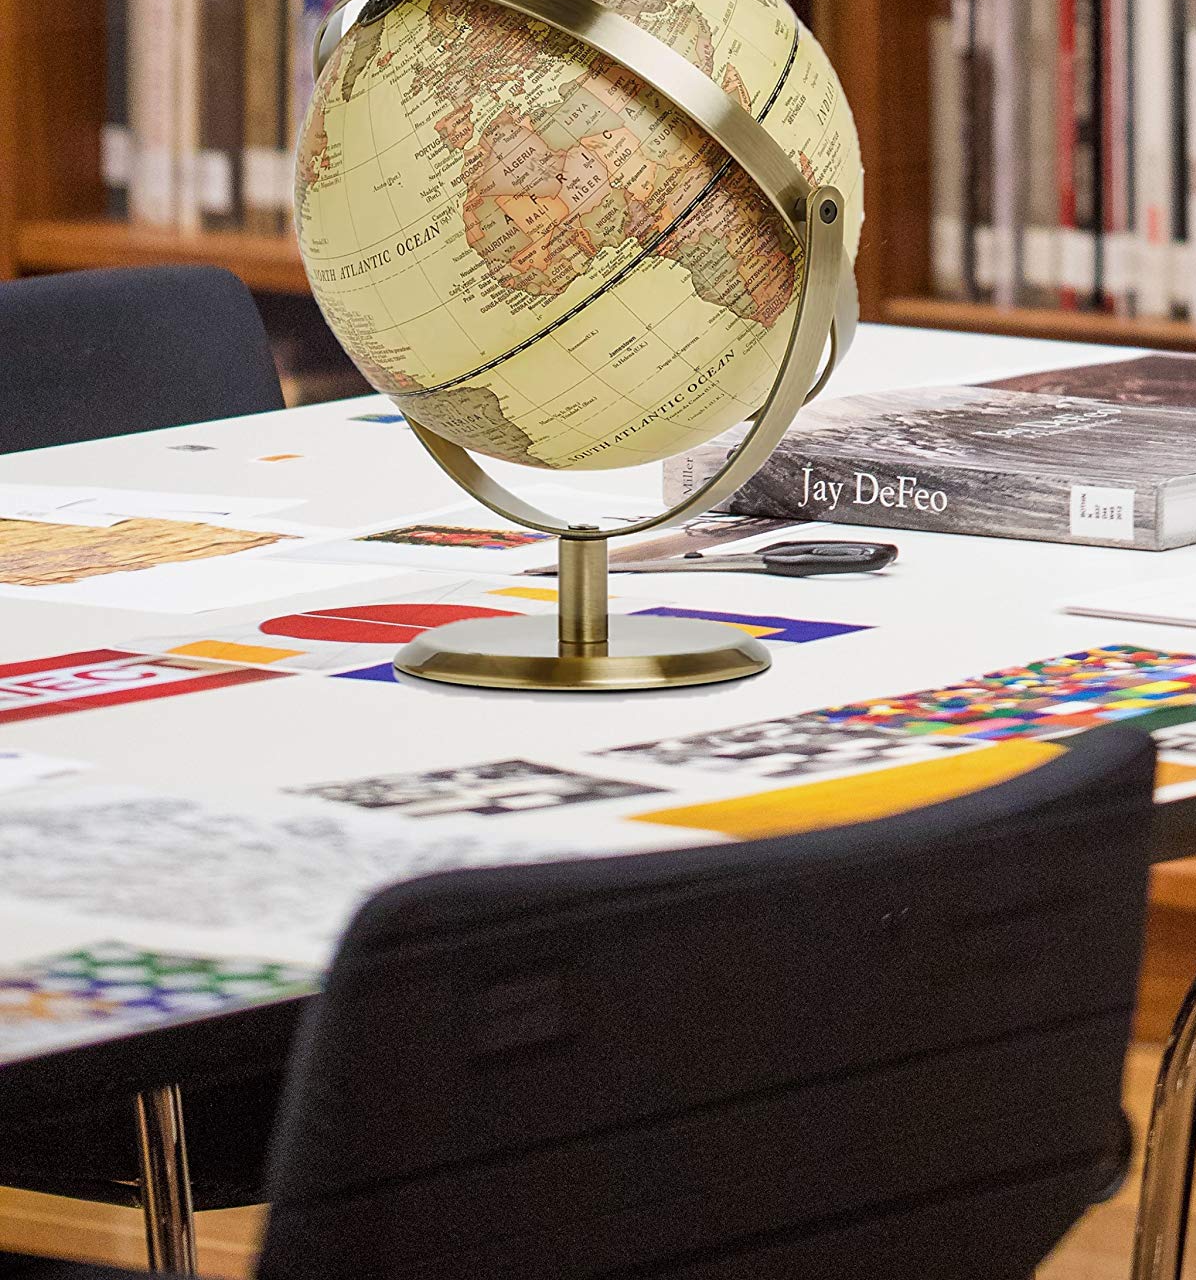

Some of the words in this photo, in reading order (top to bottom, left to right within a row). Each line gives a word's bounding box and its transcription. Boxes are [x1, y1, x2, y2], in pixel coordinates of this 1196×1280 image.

[434, 85, 458, 105] FRANCE
[606, 76, 626, 95] EGYPT
[526, 89, 544, 105] MALTA
[507, 102, 522, 115] Tunis
[529, 109, 547, 125] Tripoli
[563, 102, 589, 125] LIBYA
[450, 126, 471, 143] SPAIN
[653, 118, 680, 145] SUDAN
[414, 131, 449, 160] PORTUGAL
[427, 145, 444, 159] Lisbon
[468, 150, 483, 164] Rabat
[500, 145, 536, 176] ALGERIA
[613, 148, 632, 167] CHAD
[450, 160, 483, 188] MOROCCO
[571, 174, 601, 202] NIGER
[643, 187, 664, 207] CENTRAL
[660, 167, 683, 189] AFRICAN
[654, 181, 678, 203] REPUBLIC
[524, 204, 549, 225] MALI
[595, 206, 618, 228] NIGERIA
[340, 249, 392, 280] ATLANTIC
[396, 221, 441, 257] OCEAN
[478, 225, 520, 258] MAURITANIA
[518, 249, 536, 264] Bamako
[481, 262, 504, 280] SENEGAL
[516, 272, 537, 288] GUINEA
[743, 258, 772, 288] BOTSWANA
[478, 278, 491, 289] Dakar
[481, 283, 498, 297] GAMBIA
[717, 278, 741, 301] NAMIBIA
[463, 293, 474, 303] Praia
[505, 291, 523, 305] Conakry
[510, 302, 527, 315] SIERRA
[608, 335, 637, 359] Jamestown
[567, 441, 611, 463] SOUTH
[614, 393, 686, 444] ATLANTIC
[688, 349, 736, 393] OCEAN
[682, 457, 694, 495] Miller
[798, 462, 843, 511] Jay
[853, 471, 948, 513] DeFeo
